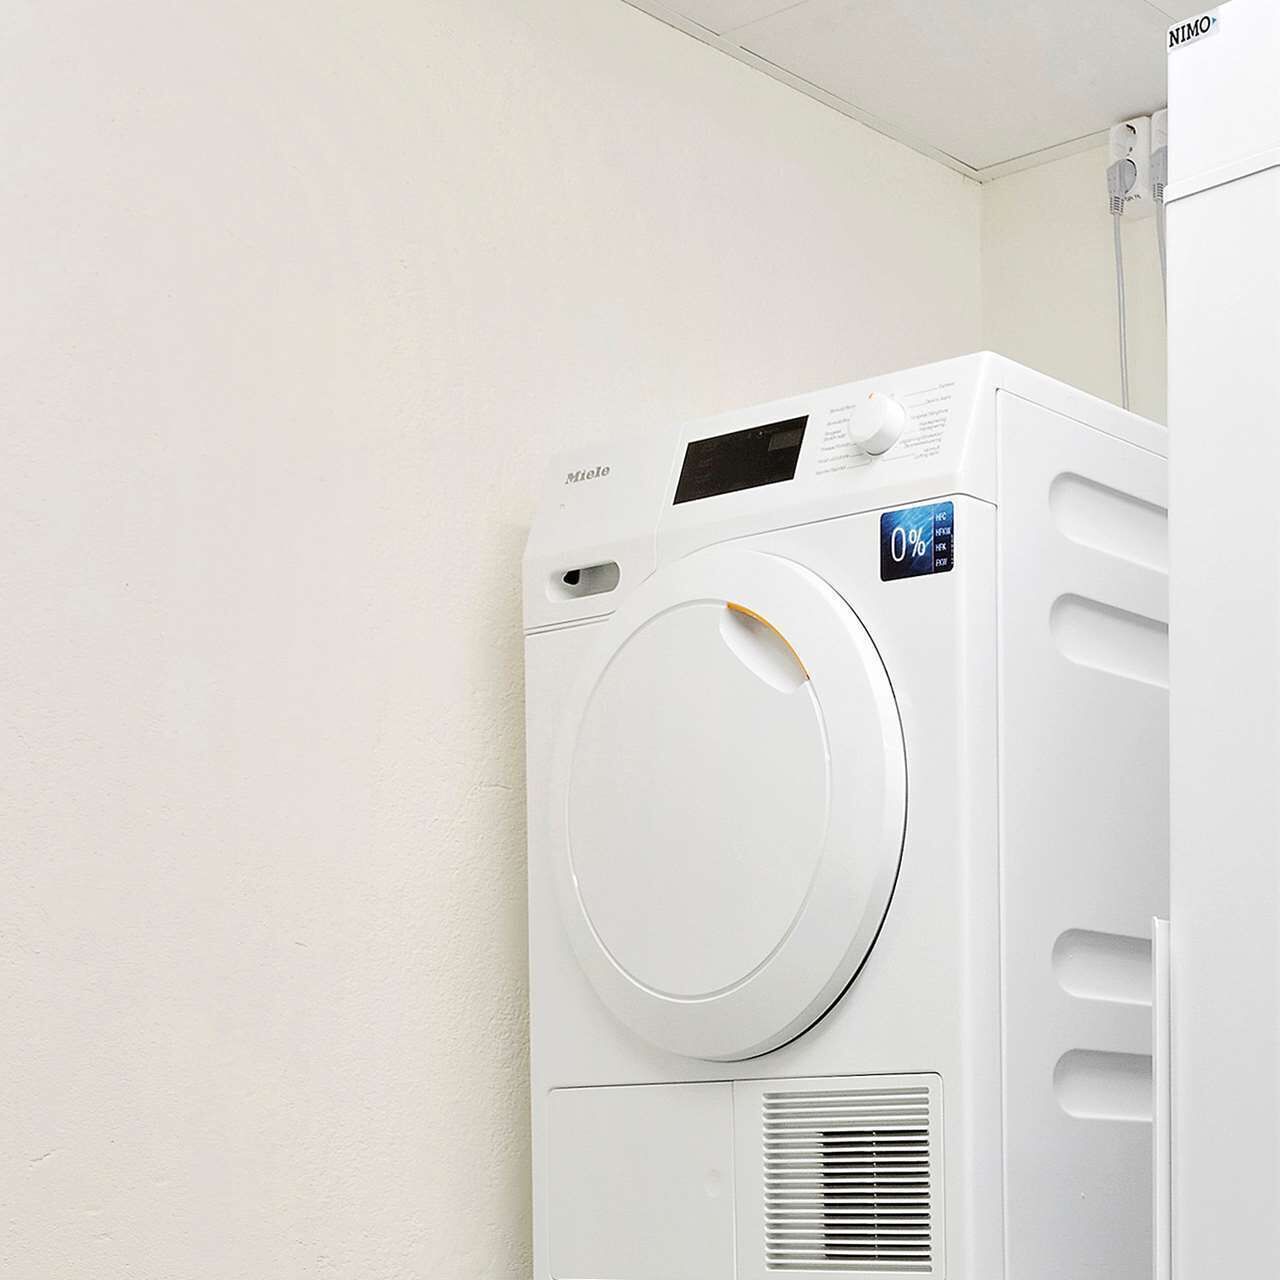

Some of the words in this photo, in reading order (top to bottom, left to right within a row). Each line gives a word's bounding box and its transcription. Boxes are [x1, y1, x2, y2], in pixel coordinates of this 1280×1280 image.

[1169, 15, 1210, 48] NIMO
[565, 465, 610, 485] Miele
[891, 526, 926, 562] 0%
